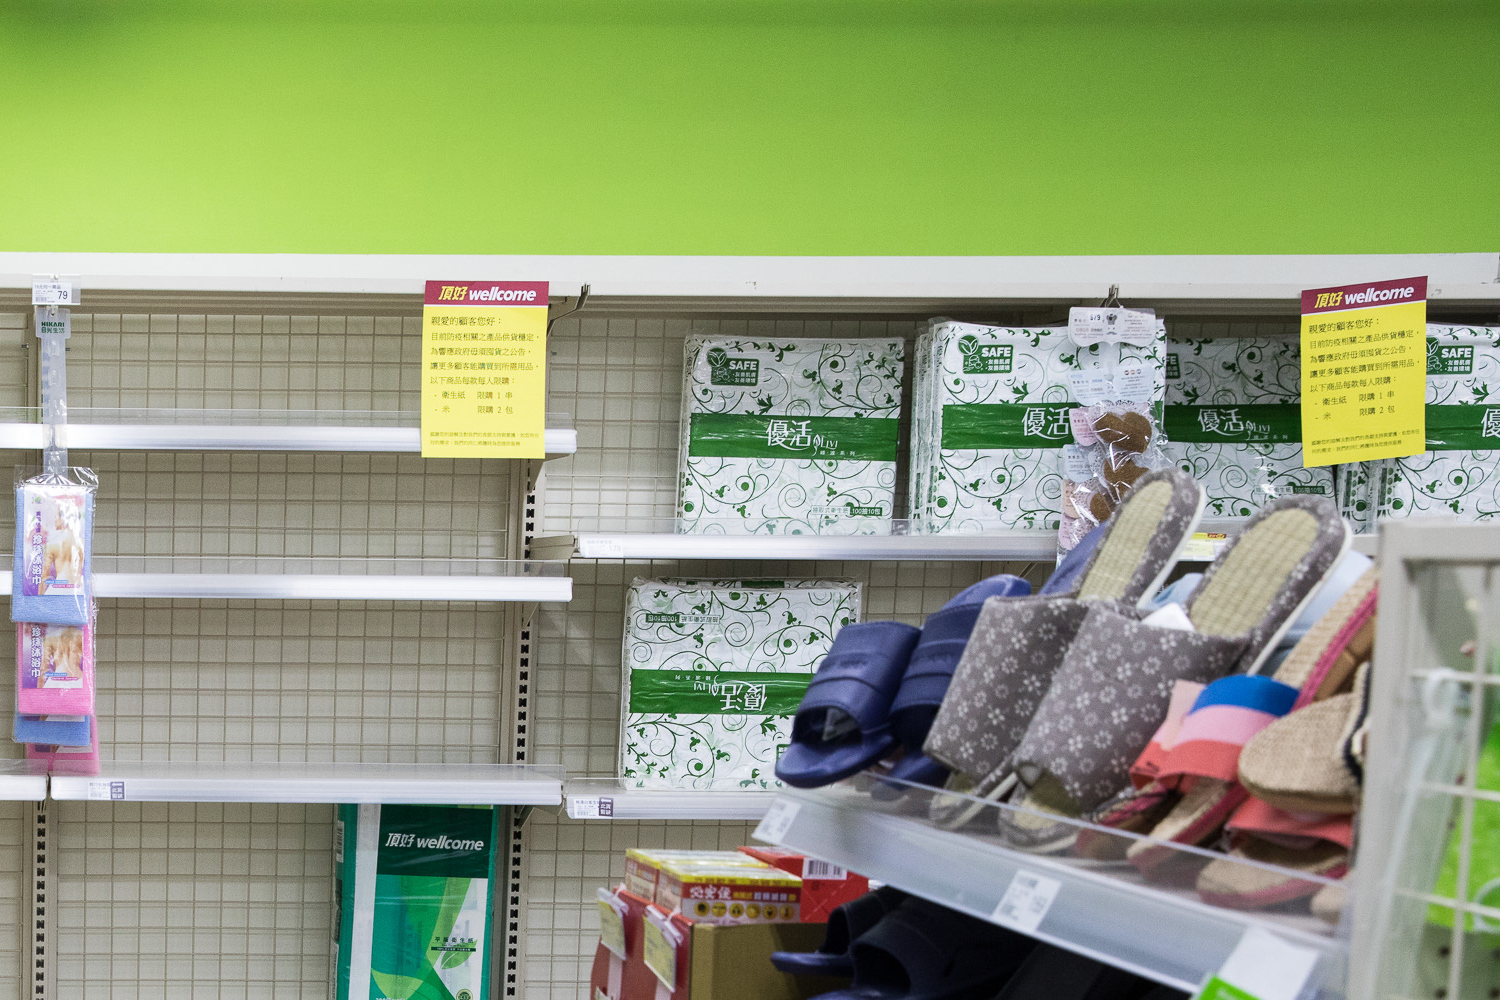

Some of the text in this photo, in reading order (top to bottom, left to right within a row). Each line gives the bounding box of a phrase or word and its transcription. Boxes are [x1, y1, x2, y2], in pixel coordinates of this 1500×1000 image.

[58, 291, 68, 299] 79
[438, 286, 536, 301] 頂好 wellcome
[1314, 287, 1414, 308] 頂好 wellcome
[981, 347, 1011, 357] SAFE
[1442, 348, 1471, 358] SAFE
[729, 361, 757, 371] SAFE
[477, 391, 493, 399] 限購
[505, 391, 513, 400] 串
[1359, 393, 1375, 401] 限購
[1387, 391, 1395, 399] 串
[477, 406, 493, 414] 限購
[505, 406, 513, 414] 包
[1323, 412, 1331, 420] 米
[1360, 408, 1375, 416] 限購
[1388, 405, 1395, 414] 包
[1022, 407, 1070, 437] 優活
[1198, 408, 1244, 432] 優活
[1481, 408, 1500, 437] 優
[766, 419, 812, 447] 優活
[31, 627, 41, 678] 珍珠沐浴巾
[720, 684, 767, 711] 優活
[385, 833, 484, 850] 頂好 wellcome
